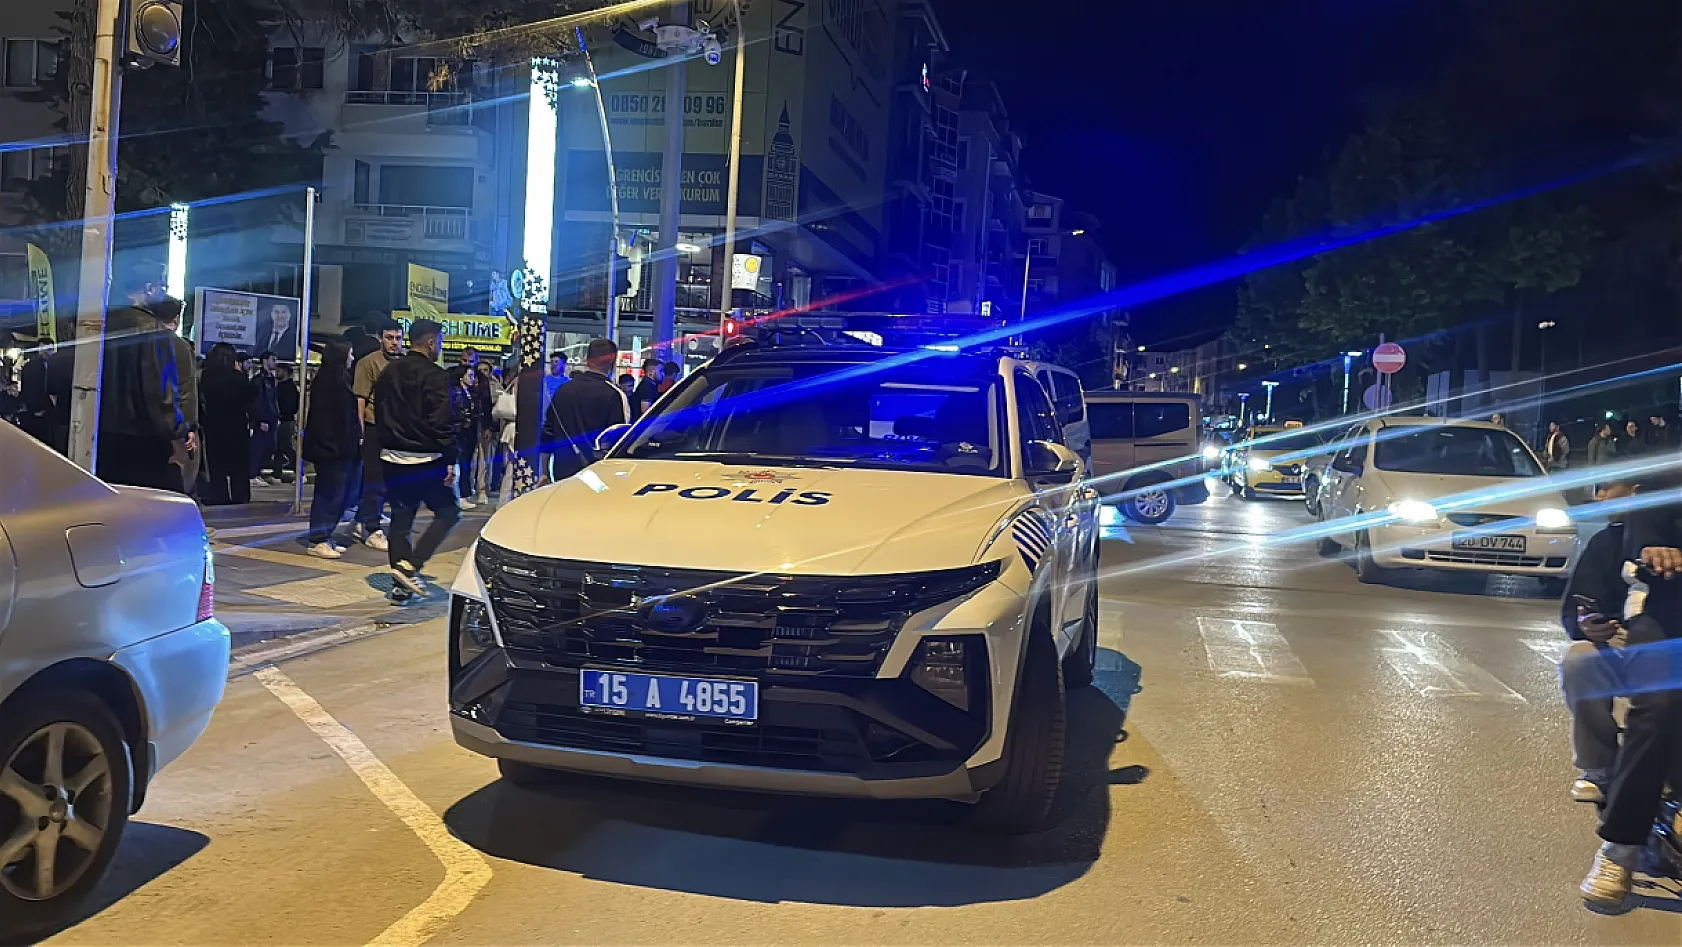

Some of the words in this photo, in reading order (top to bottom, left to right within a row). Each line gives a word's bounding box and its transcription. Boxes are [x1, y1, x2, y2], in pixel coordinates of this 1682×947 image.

[611, 95, 648, 113] 0850
[684, 96, 702, 114] 09
[706, 96, 724, 114] 96
[464, 320, 502, 339] TIME
[632, 483, 833, 506] POLİS
[1500, 537, 1523, 549] 744
[583, 689, 596, 698] TR
[598, 673, 628, 705] 15
[645, 677, 662, 708] A
[679, 680, 747, 715] 4855
